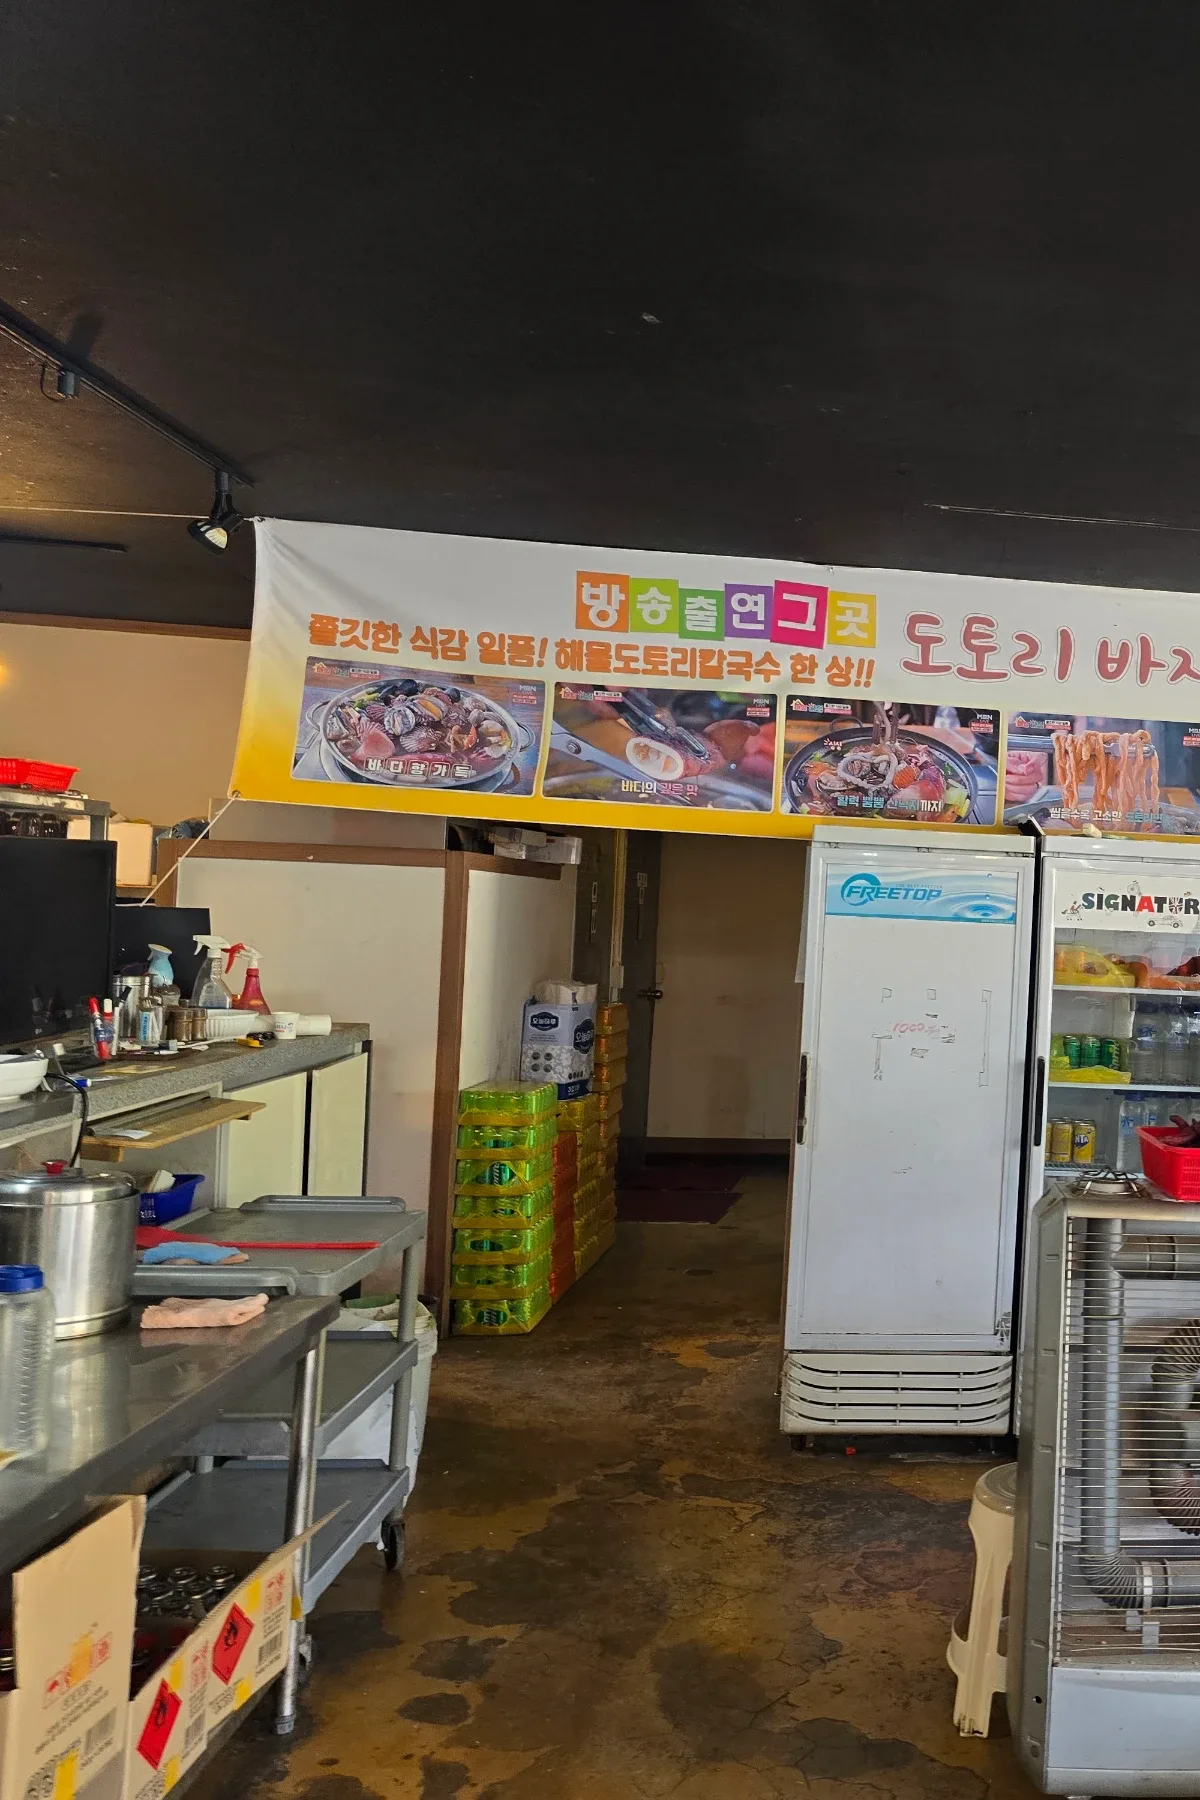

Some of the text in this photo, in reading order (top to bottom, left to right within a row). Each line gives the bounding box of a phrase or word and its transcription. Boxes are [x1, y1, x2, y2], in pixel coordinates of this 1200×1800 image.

[308, 613, 875, 689] 쫄깃한 식감 일품! 해물도토리칼국수 한 상!!
[902, 610, 1075, 684] 도토리
[622, 780, 657, 795] 바다의
[687, 784, 698, 796] 맛
[846, 885, 942, 901] FREETOP
